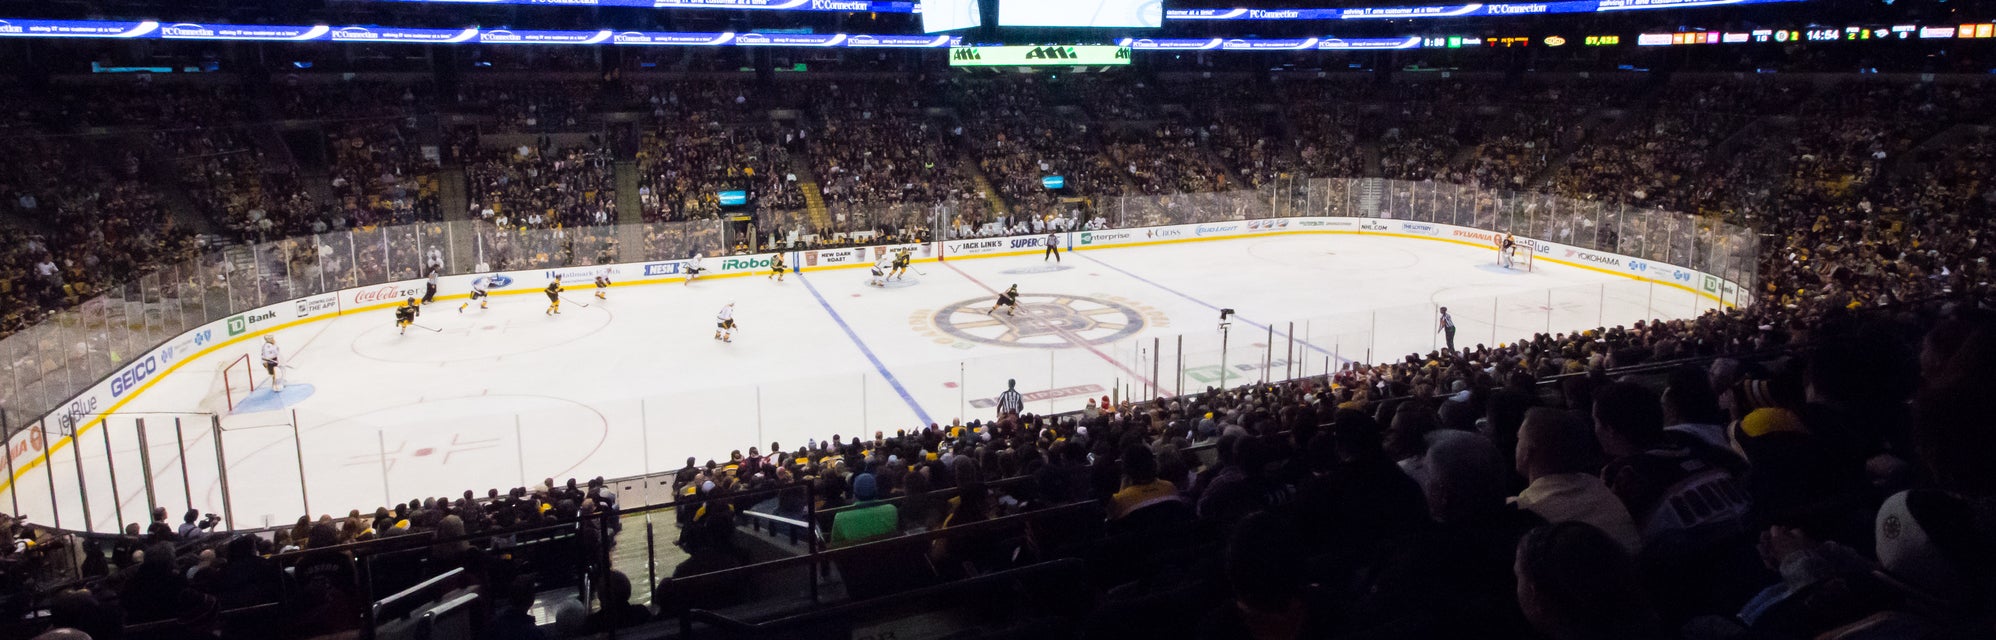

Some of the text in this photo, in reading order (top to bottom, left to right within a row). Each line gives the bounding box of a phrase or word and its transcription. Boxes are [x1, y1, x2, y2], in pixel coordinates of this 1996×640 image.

[812, 0, 868, 10] PC Connection
[1501, 5, 1547, 14] Connection
[1250, 10, 1298, 18] PC Connection
[174, 28, 213, 37] Connection
[342, 30, 377, 39] Connection
[1789, 31, 1799, 41] 2
[1806, 29, 1840, 41] 14:54
[1860, 29, 1870, 40] 2
[1453, 229, 1492, 242] SYLVANIA
[963, 242, 979, 250] JACK
[722, 257, 772, 271] iRobo
[1577, 252, 1621, 268] YOKOHAMA
[651, 263, 674, 274] NESN
[248, 311, 276, 325] Bank
[110, 356, 157, 398] GEICO
